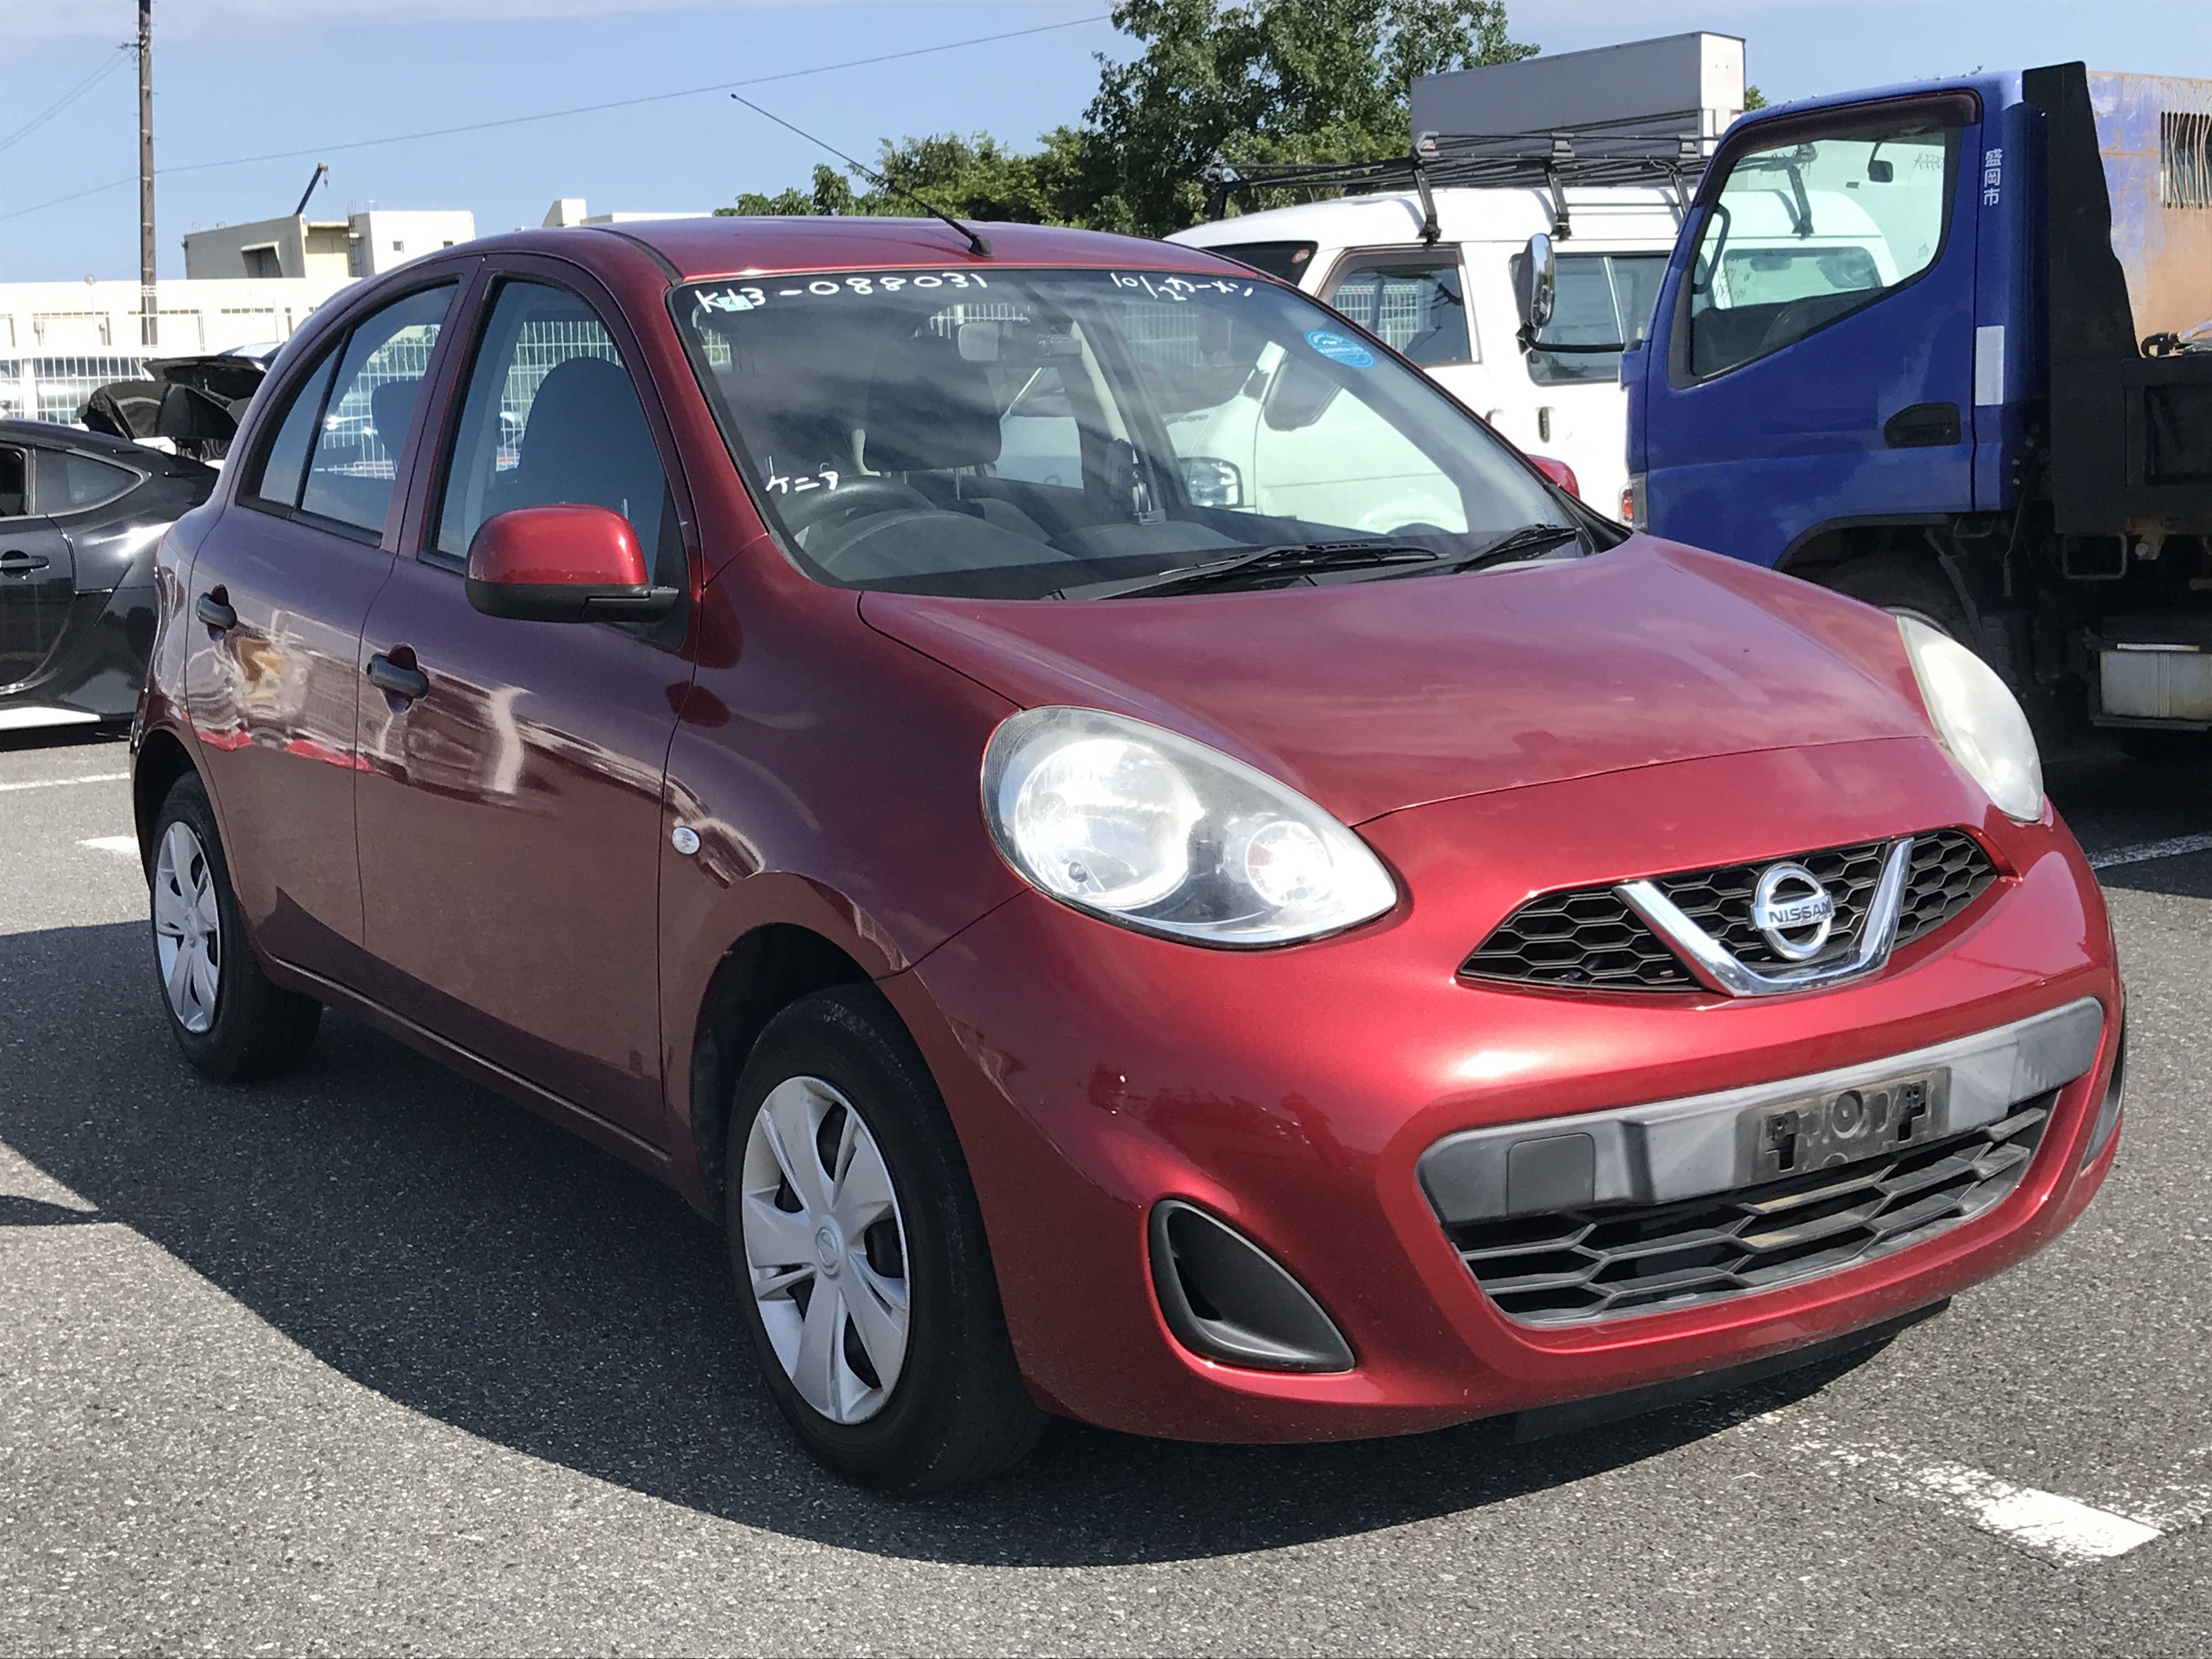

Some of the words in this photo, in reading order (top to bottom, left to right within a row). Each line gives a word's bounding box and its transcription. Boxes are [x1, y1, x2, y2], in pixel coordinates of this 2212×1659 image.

[1983, 148, 2002, 206] 盛岡市
[695, 273, 988, 313] K13-088031
[1768, 900, 1832, 923] NISSAN
